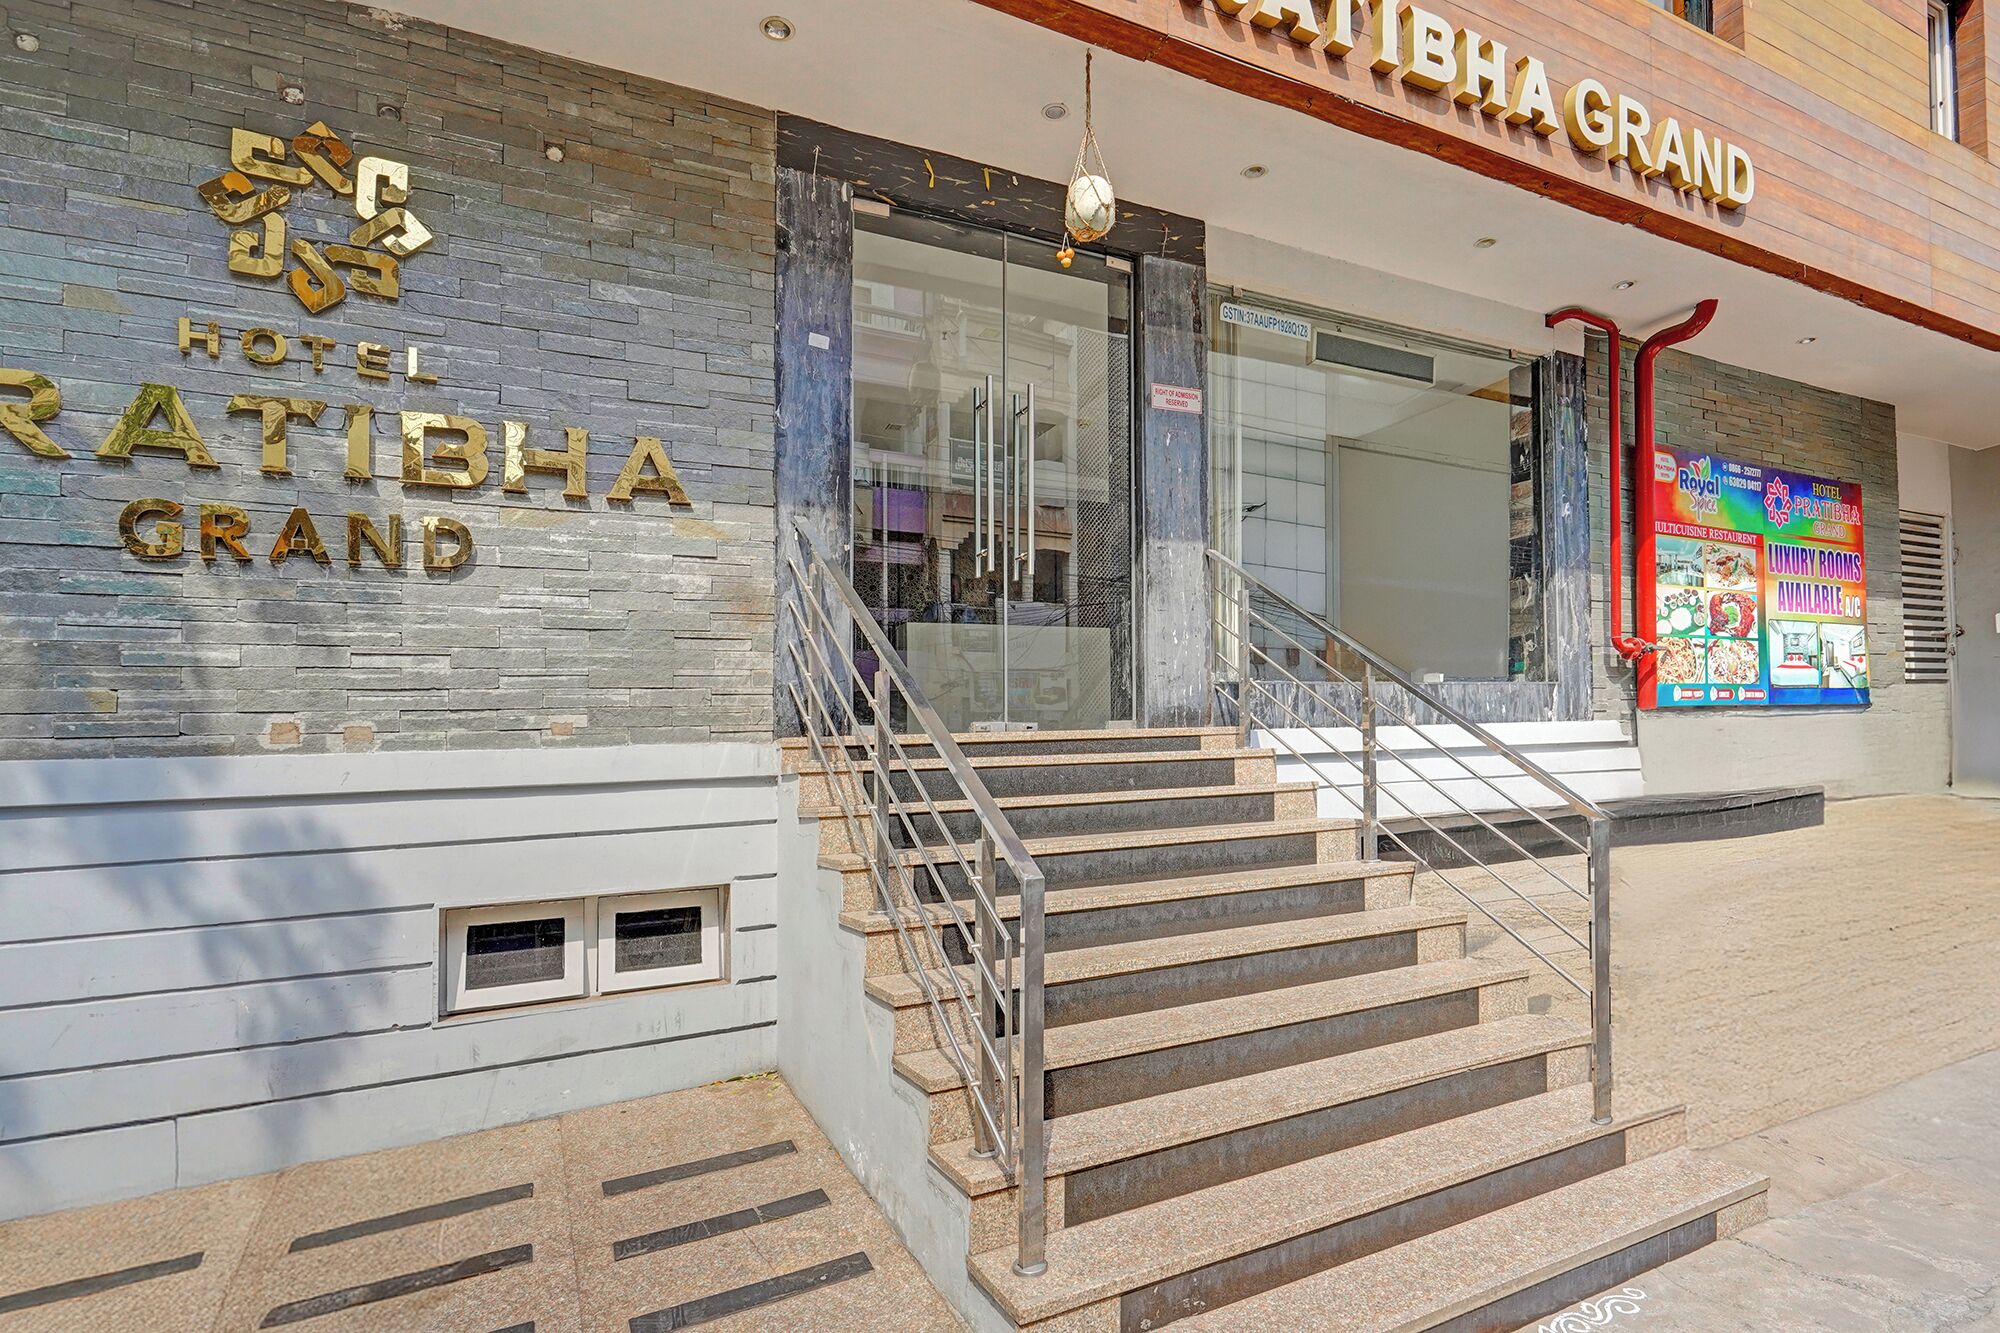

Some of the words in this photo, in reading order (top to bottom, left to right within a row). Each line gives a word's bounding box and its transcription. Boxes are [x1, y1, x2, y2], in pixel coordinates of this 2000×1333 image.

[1563, 78, 1755, 209] GRAND
[178, 317, 438, 384] HOTEL
[1155, 388, 1168, 396] RIGHT
[1175, 391, 1199, 400] ADMISSION
[1165, 398, 1189, 408] RESERVED
[1679, 468, 1720, 498] Royal
[1812, 483, 1843, 500] HOTEL
[1690, 488, 1717, 521] Spice
[1794, 496, 1861, 525] PRATIBHA
[118, 497, 474, 571] GRAND
[1655, 521, 1708, 538] ULTICUISINE
[1709, 528, 1757, 544] RESTAURENT
[1813, 521, 1846, 538] GRAND
[1768, 542, 1816, 577] LUXURY
[1818, 549, 1862, 583] ROOMS
[1777, 580, 1843, 616] AVAILABLE
[1845, 595, 1860, 618] A/C
